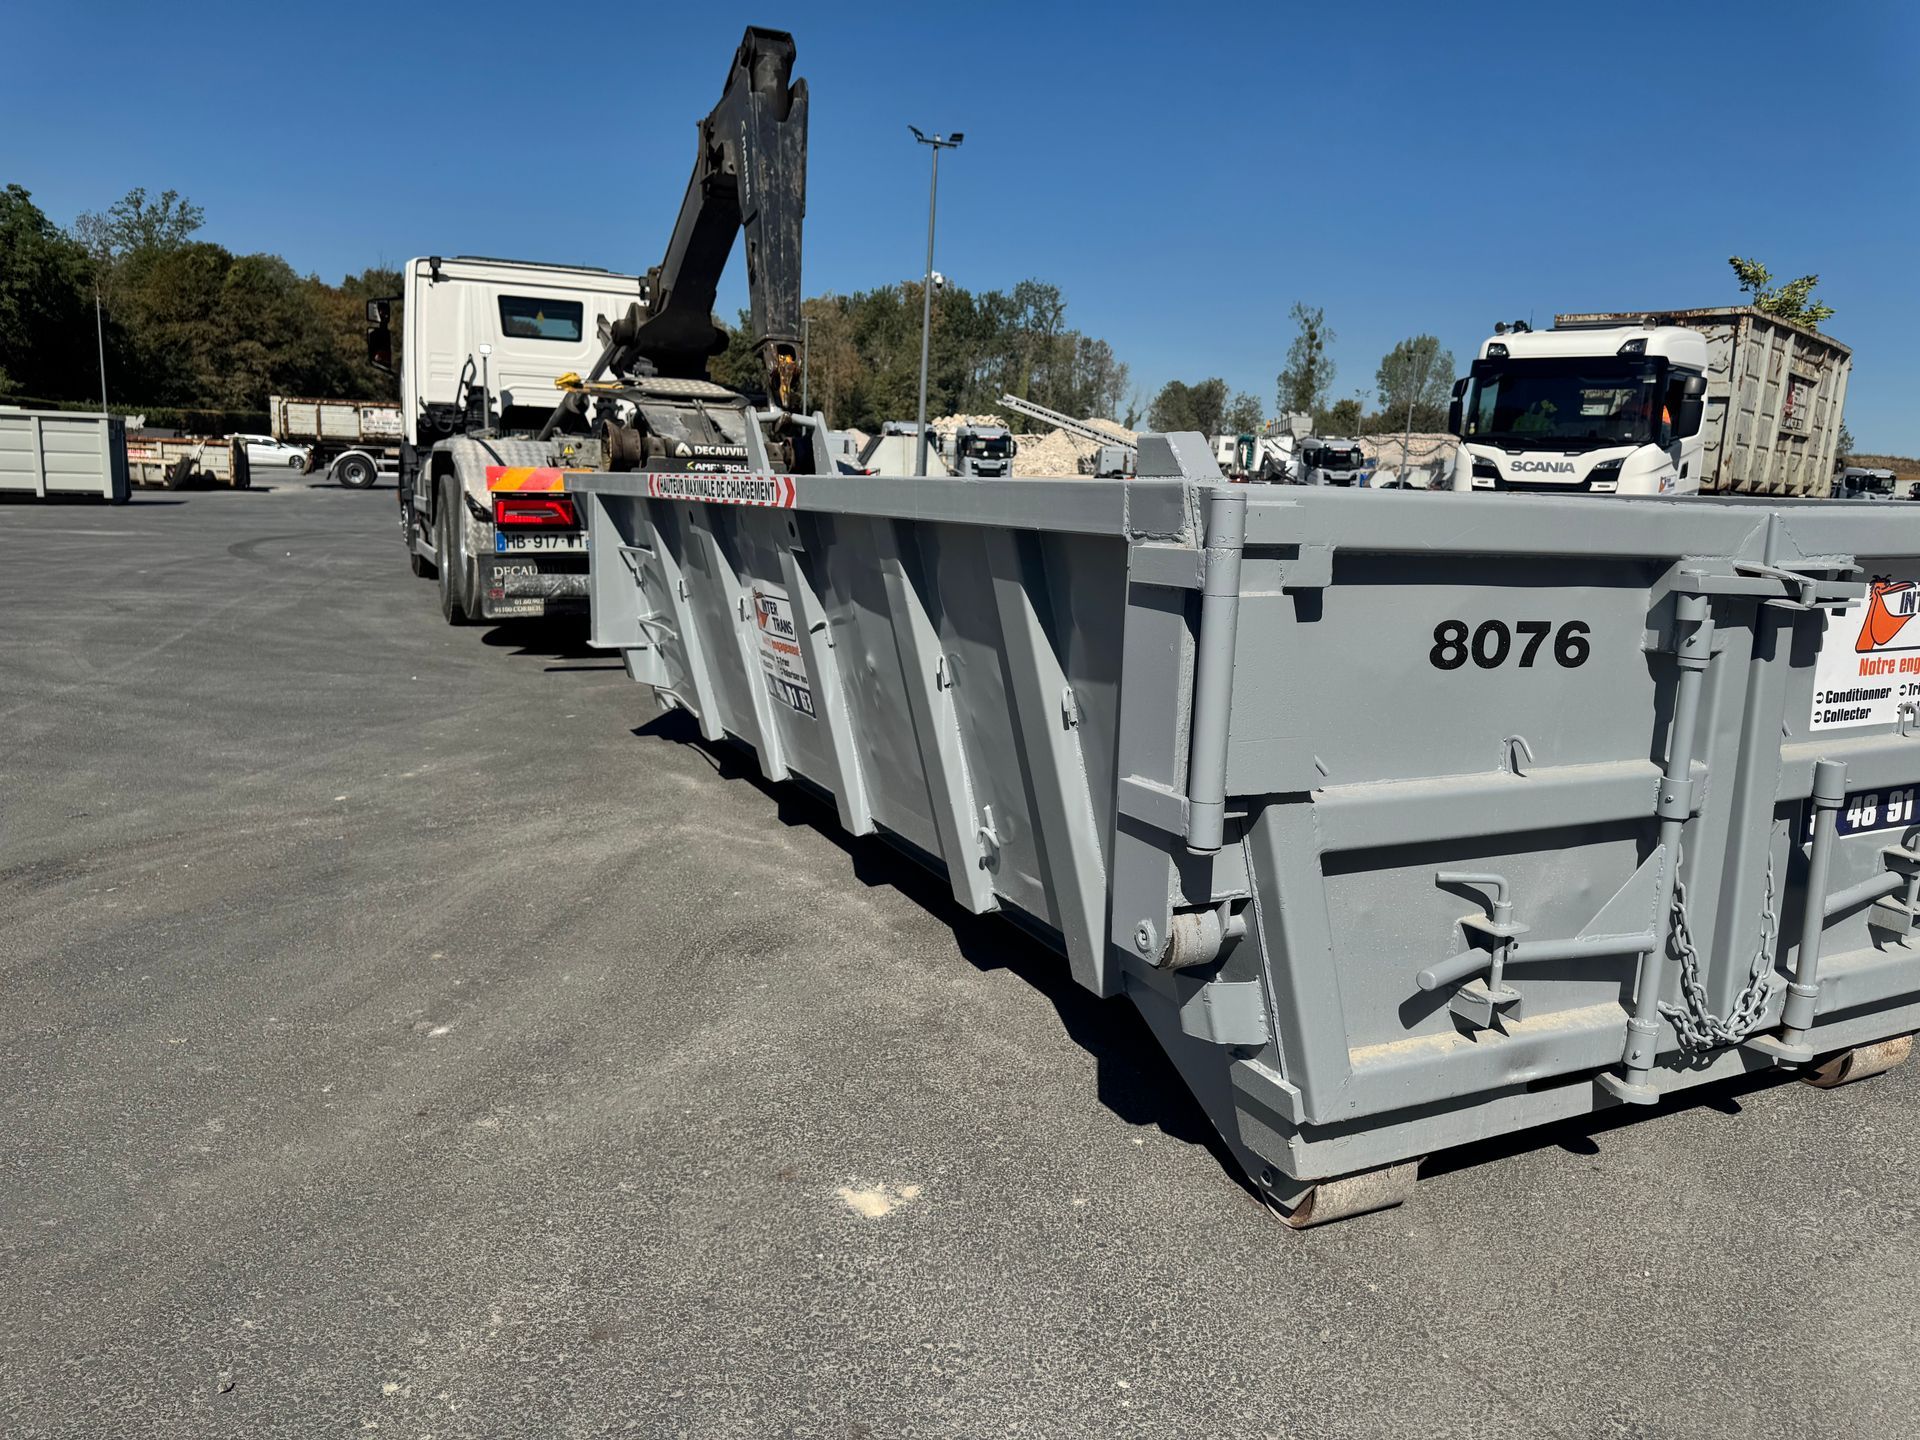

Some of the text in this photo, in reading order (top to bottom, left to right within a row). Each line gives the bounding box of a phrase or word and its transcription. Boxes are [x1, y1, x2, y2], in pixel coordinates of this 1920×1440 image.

[1510, 461, 1576, 474] SCANIA
[660, 478, 776, 502] HAUTEUR MAXIMALE DE CHARGEMENT
[505, 534, 585, 549] HB-917-WT
[772, 617, 794, 635] TRANS
[1429, 619, 1591, 671] 8076
[1859, 657, 1895, 676] Notre
[1825, 687, 1892, 704] Conditionner
[1823, 707, 1872, 723] Collecter
[1846, 795, 1879, 829] 48
[1886, 788, 1915, 823] 91
